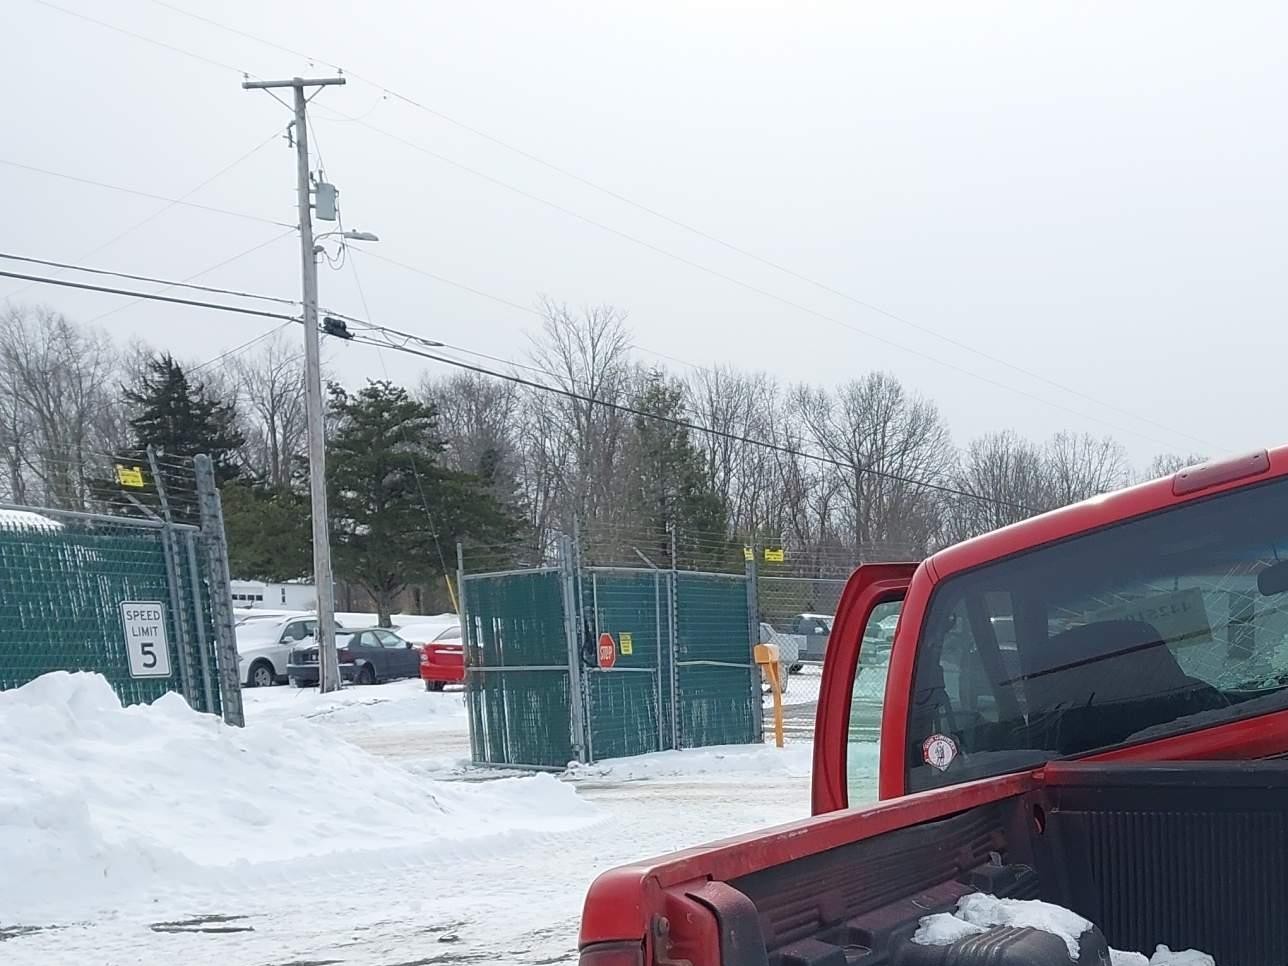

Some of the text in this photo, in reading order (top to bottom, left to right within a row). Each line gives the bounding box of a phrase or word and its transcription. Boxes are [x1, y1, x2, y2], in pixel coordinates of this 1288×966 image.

[126, 610, 160, 621] SPEED
[131, 626, 158, 637] LIMIT
[140, 642, 157, 668] 5
[600, 645, 612, 660] STOP
